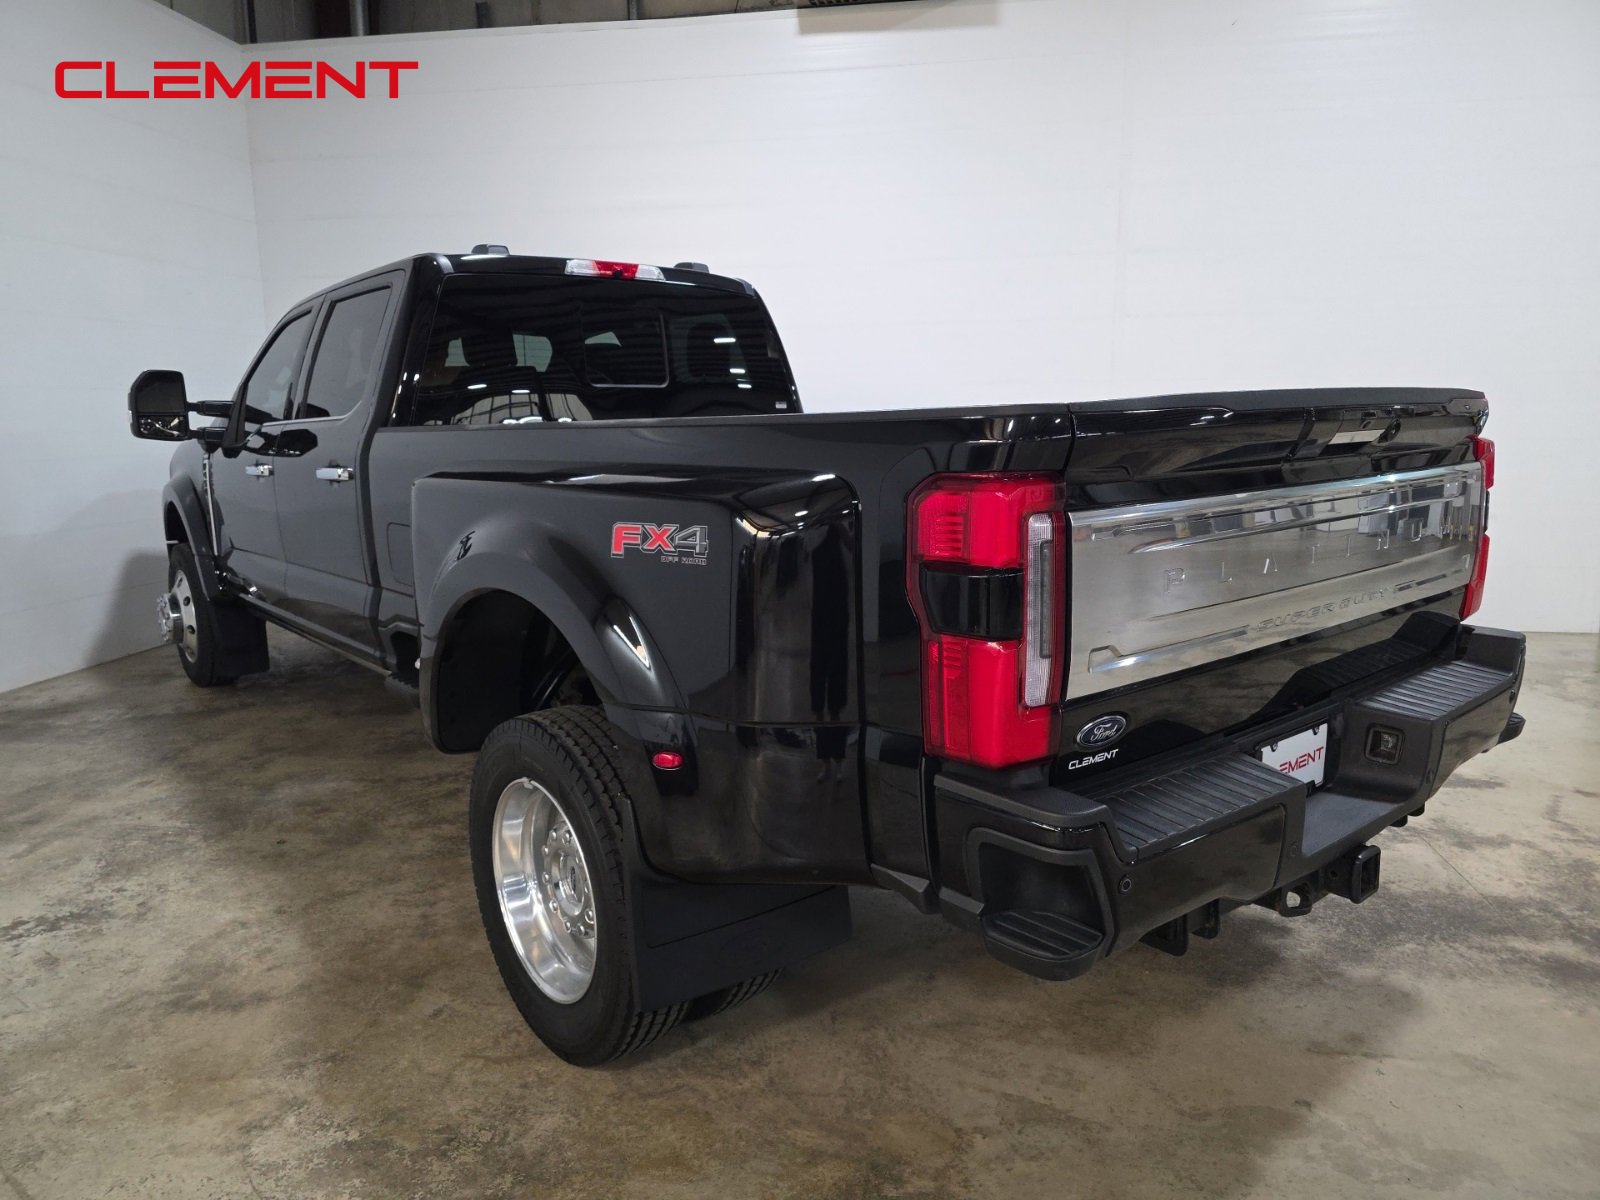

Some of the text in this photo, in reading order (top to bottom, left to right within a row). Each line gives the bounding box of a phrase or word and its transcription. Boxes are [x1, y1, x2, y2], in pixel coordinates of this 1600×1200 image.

[610, 521, 709, 559] FX4
[660, 556, 707, 566] OFF ROAD
[1257, 602, 1336, 632] SUPER
[1090, 722, 1118, 742] Ford
[1068, 749, 1119, 770] CLEMENT
[1279, 745, 1324, 774] EMENT
